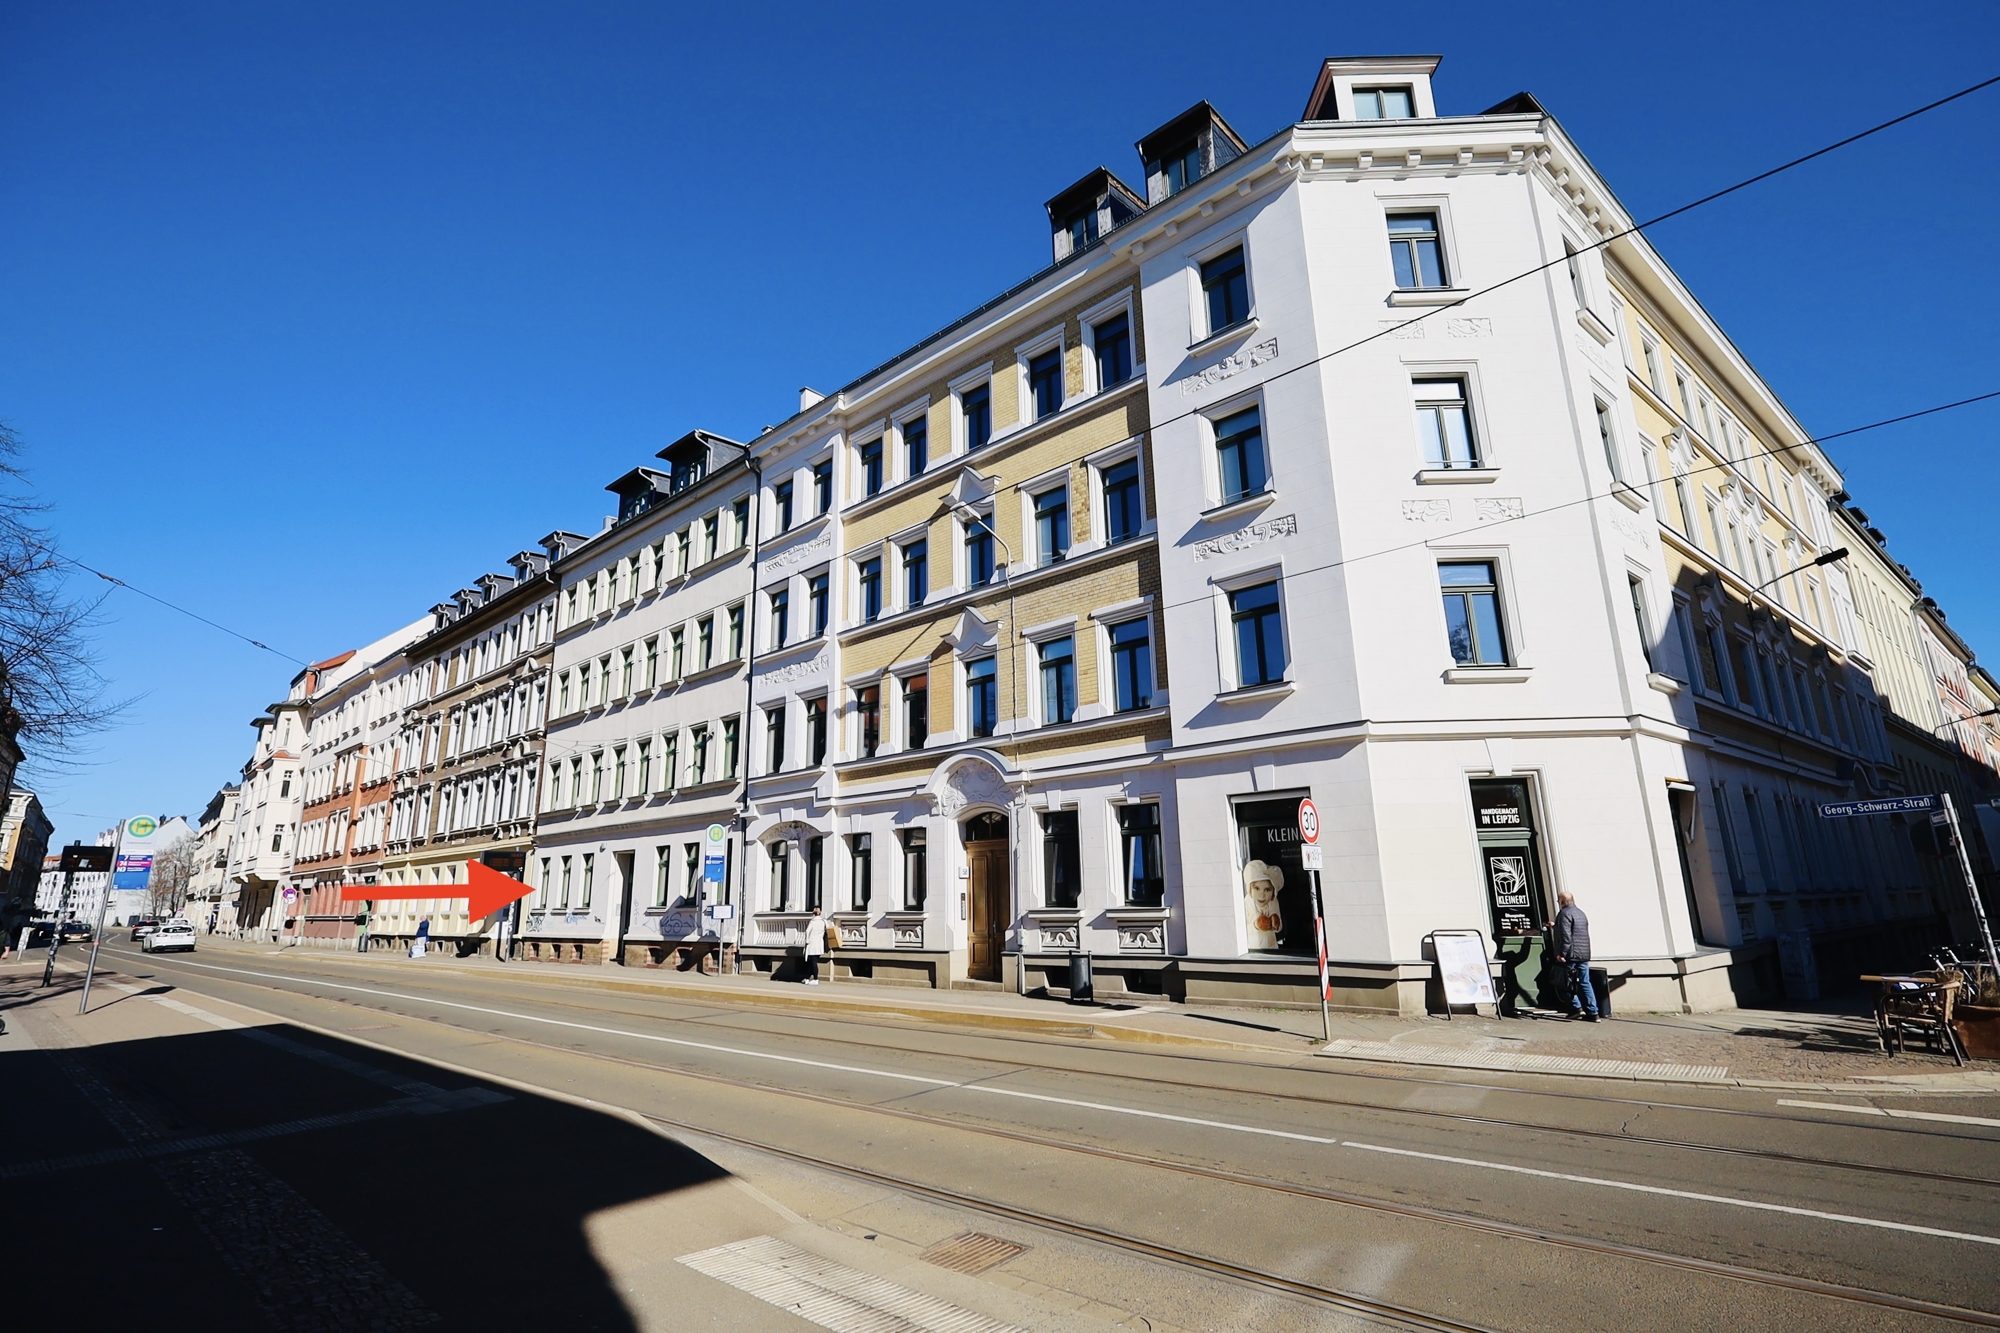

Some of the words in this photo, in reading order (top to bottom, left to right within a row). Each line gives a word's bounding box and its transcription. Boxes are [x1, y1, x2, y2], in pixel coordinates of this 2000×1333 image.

[1481, 807, 1518, 815] HANDGEMACHT
[1303, 811, 1316, 831] 30
[1482, 815, 1491, 824] IN
[1492, 815, 1520, 824] LEIPZIG
[1498, 894, 1527, 904] KLEINERT
